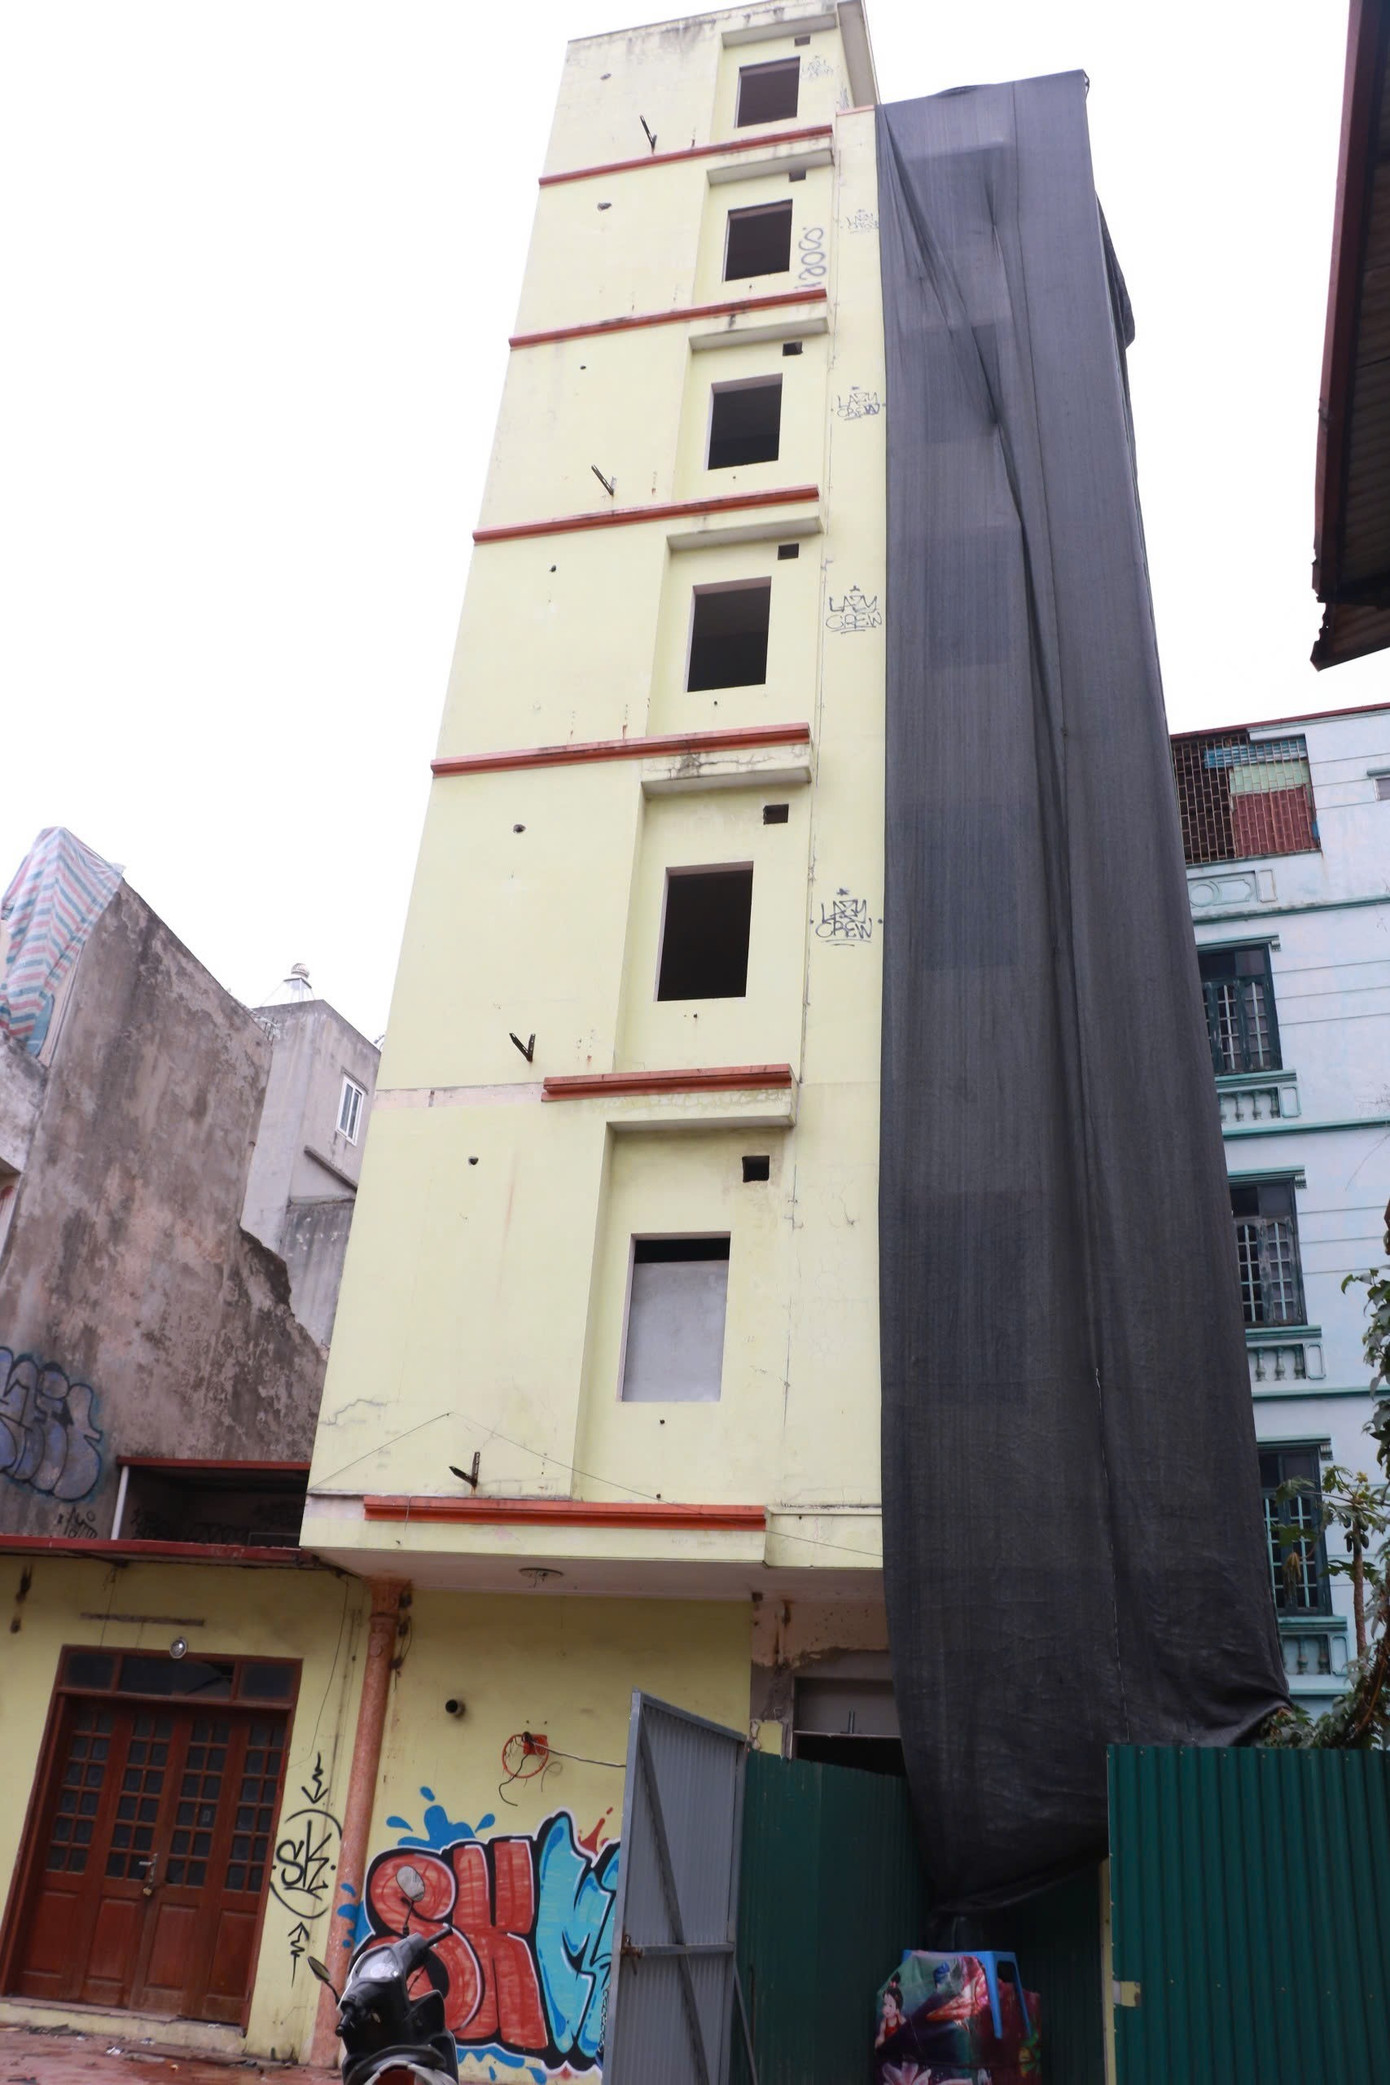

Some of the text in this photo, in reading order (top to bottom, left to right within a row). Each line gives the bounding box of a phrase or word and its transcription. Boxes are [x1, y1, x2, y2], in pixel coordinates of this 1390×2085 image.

[828, 595, 878, 613] LAZY
[821, 899, 867, 924] LAZY
[815, 917, 873, 938] CREW
